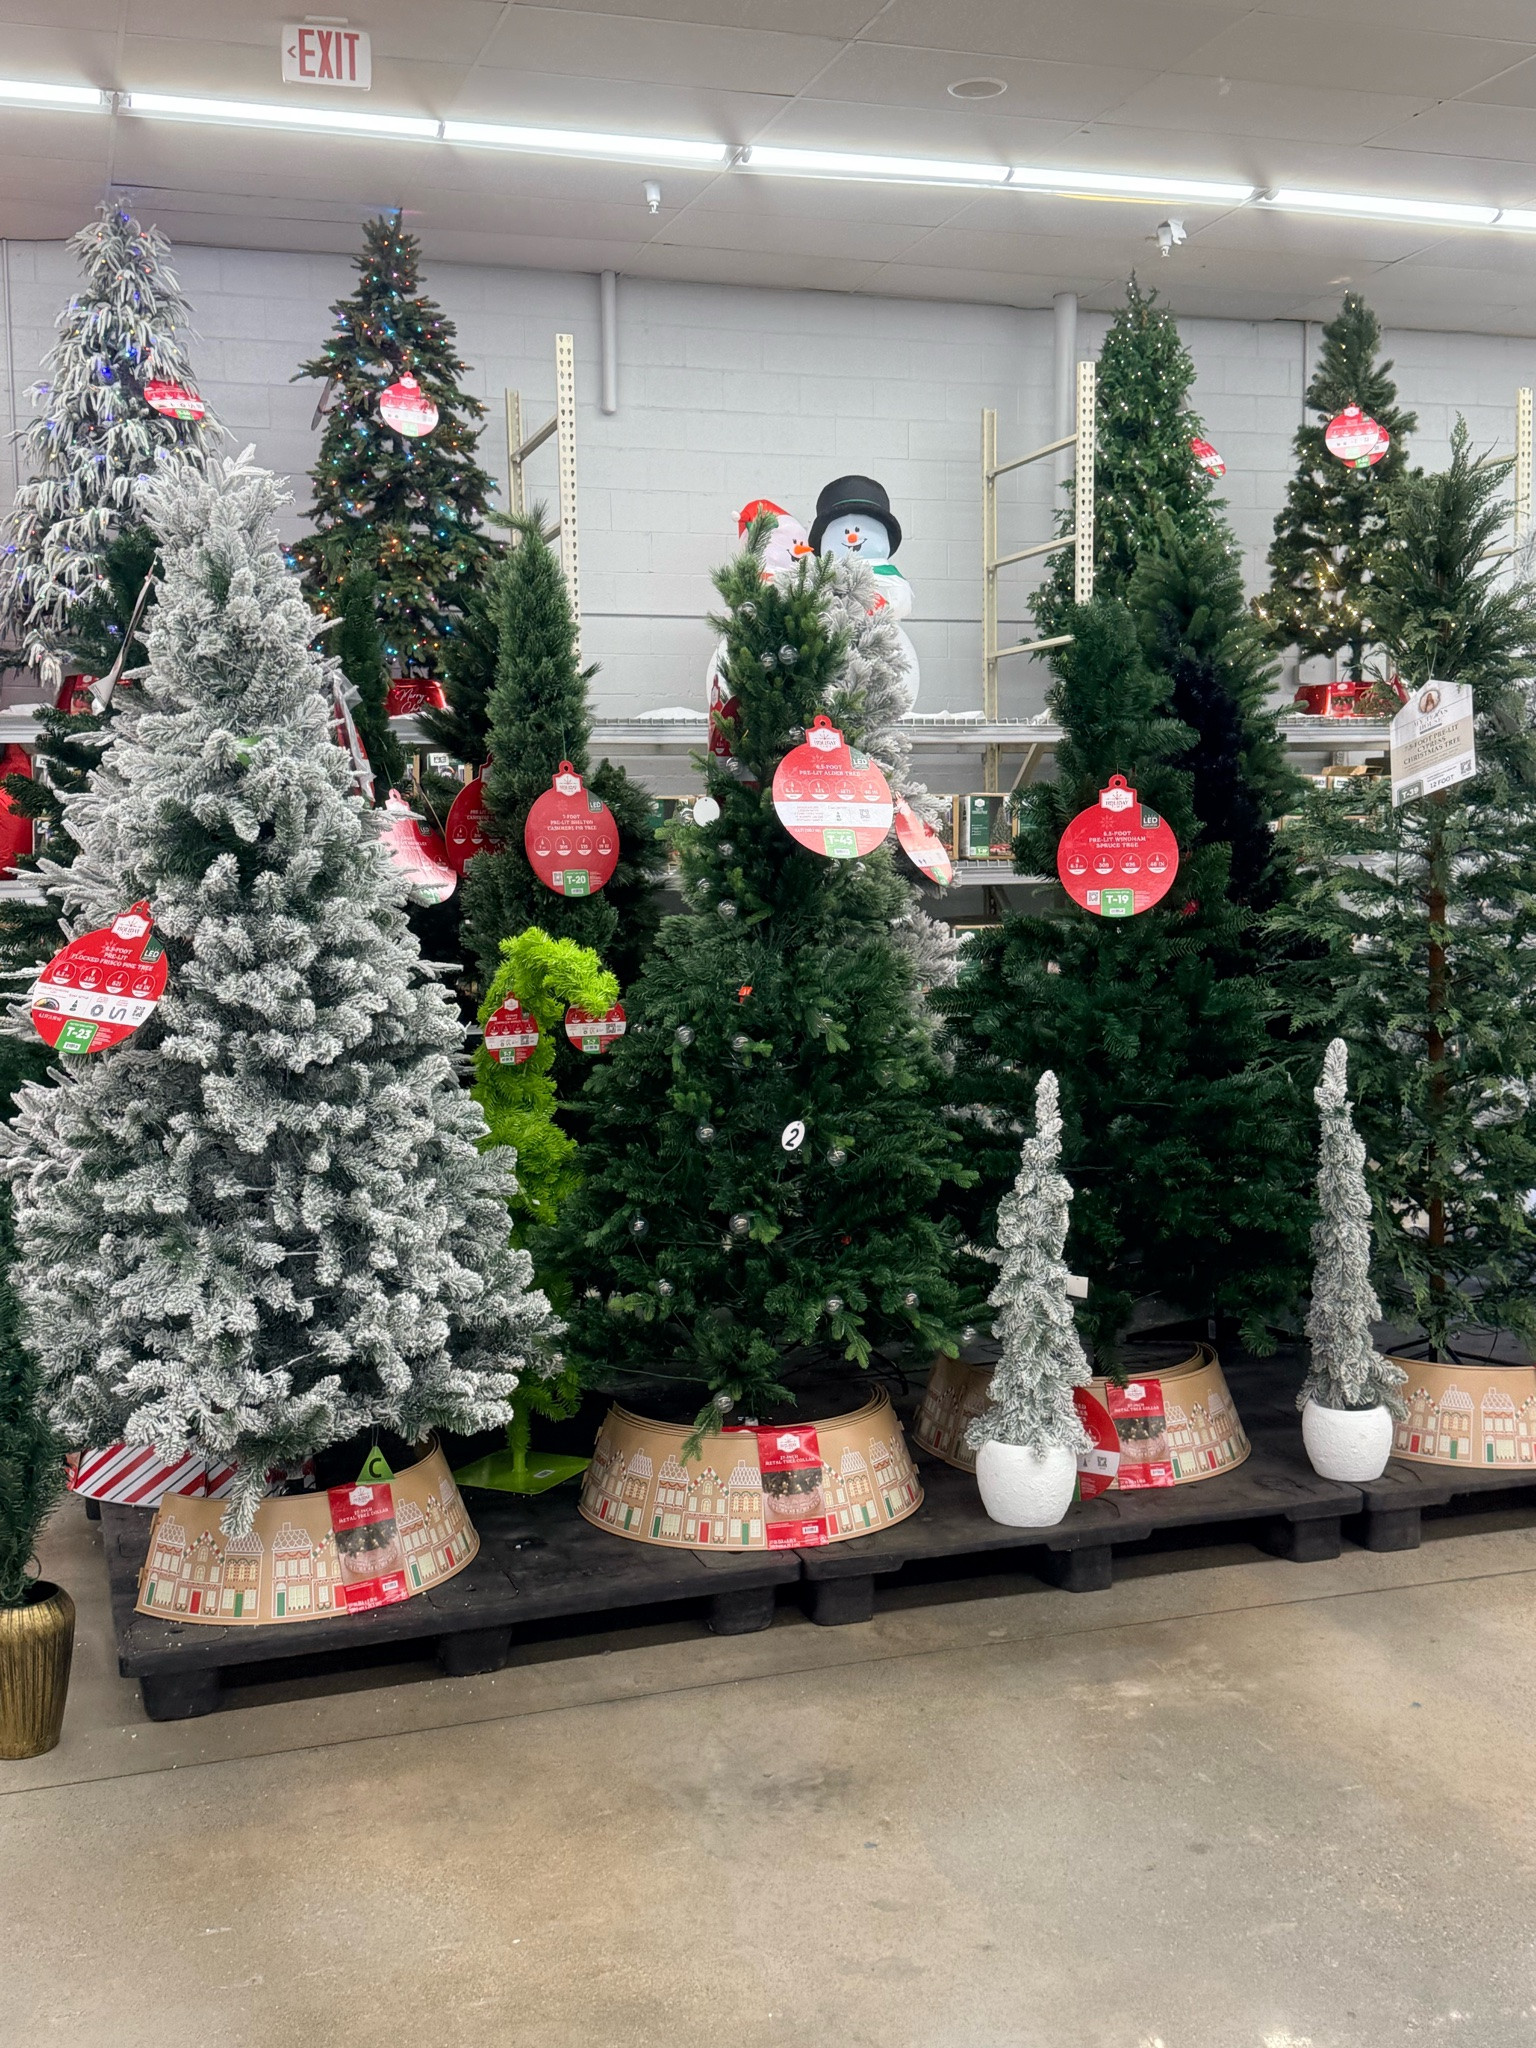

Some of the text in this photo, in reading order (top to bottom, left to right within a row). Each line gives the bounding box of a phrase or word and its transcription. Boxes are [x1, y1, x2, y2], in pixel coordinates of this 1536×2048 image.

[298, 28, 360, 81] EXIT
[1403, 736, 1461, 765] CHRISTMAS TREE
[1417, 736, 1447, 752] CYPRESS
[1437, 774, 1454, 785] FOOT
[1401, 786, 1419, 799] T-39
[826, 834, 853, 845] T-45
[566, 875, 586, 885] T-20
[1105, 894, 1129, 904] T-19
[103, 952, 129, 961] PRE-LIT
[143, 949, 160, 958] LED
[71, 953, 100, 963] FLOCKED
[100, 958, 122, 967] FRISCO
[137, 964, 154, 972] TREE
[66, 1026, 92, 1040] T-23
[785, 1128, 800, 1147] 2
[368, 1457, 382, 1479] C
[338, 1515, 357, 1524] METAL
